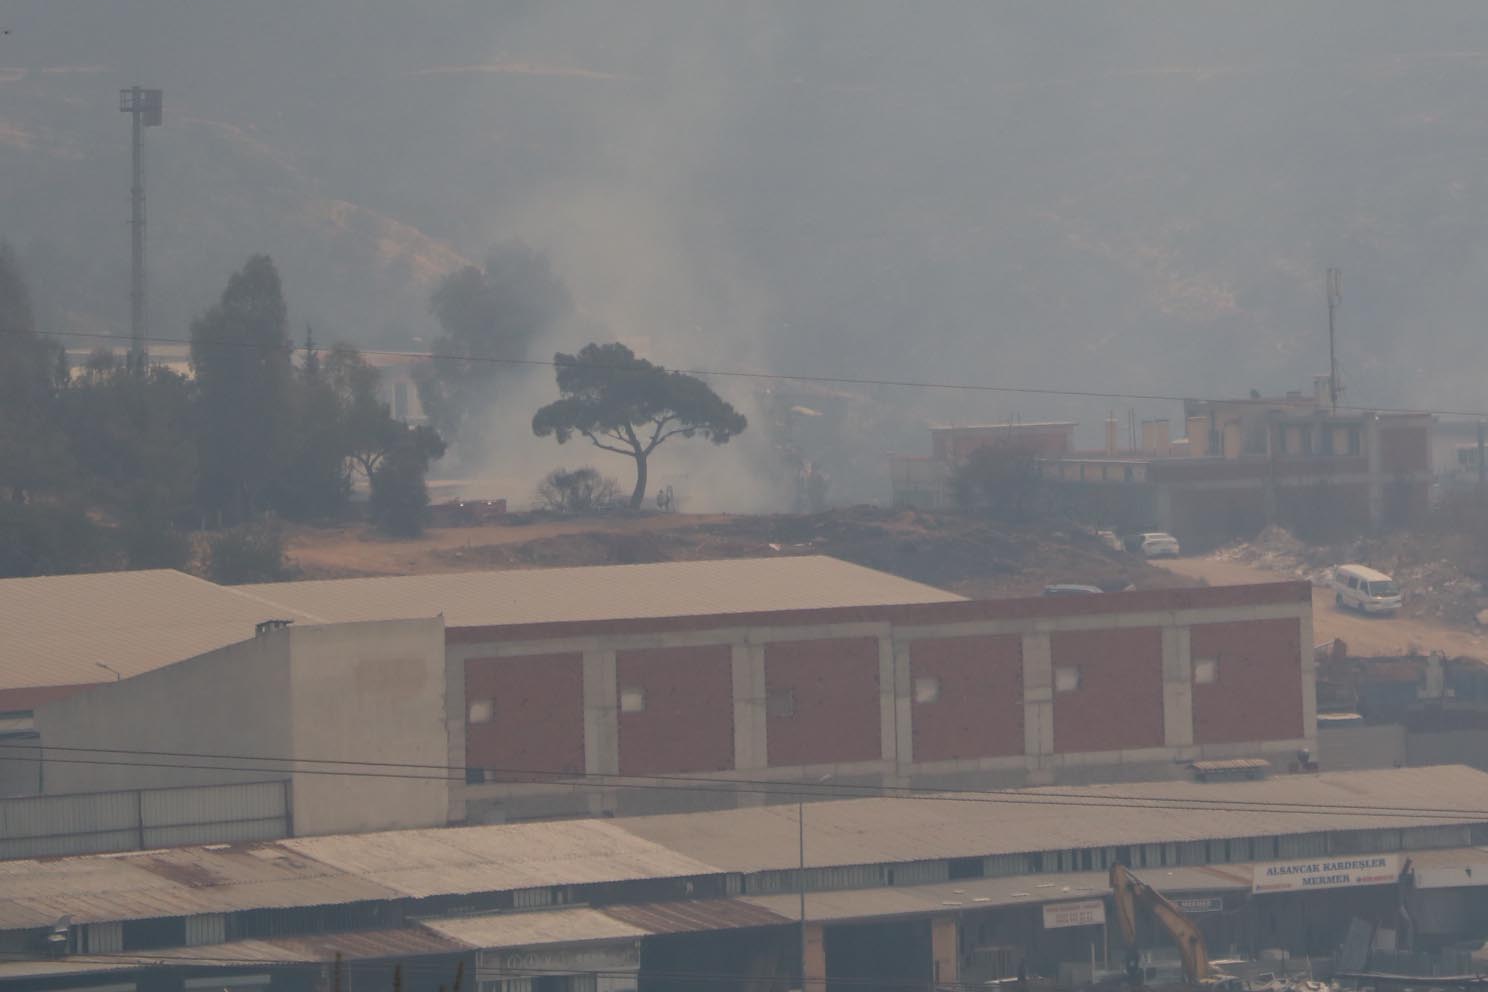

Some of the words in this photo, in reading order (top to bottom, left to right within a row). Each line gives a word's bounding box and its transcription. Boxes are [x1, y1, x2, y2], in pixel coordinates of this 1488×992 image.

[1266, 864, 1320, 876] ALSANCAK
[1323, 858, 1386, 871] KARDEŞLER
[1302, 874, 1350, 885] MERMER
